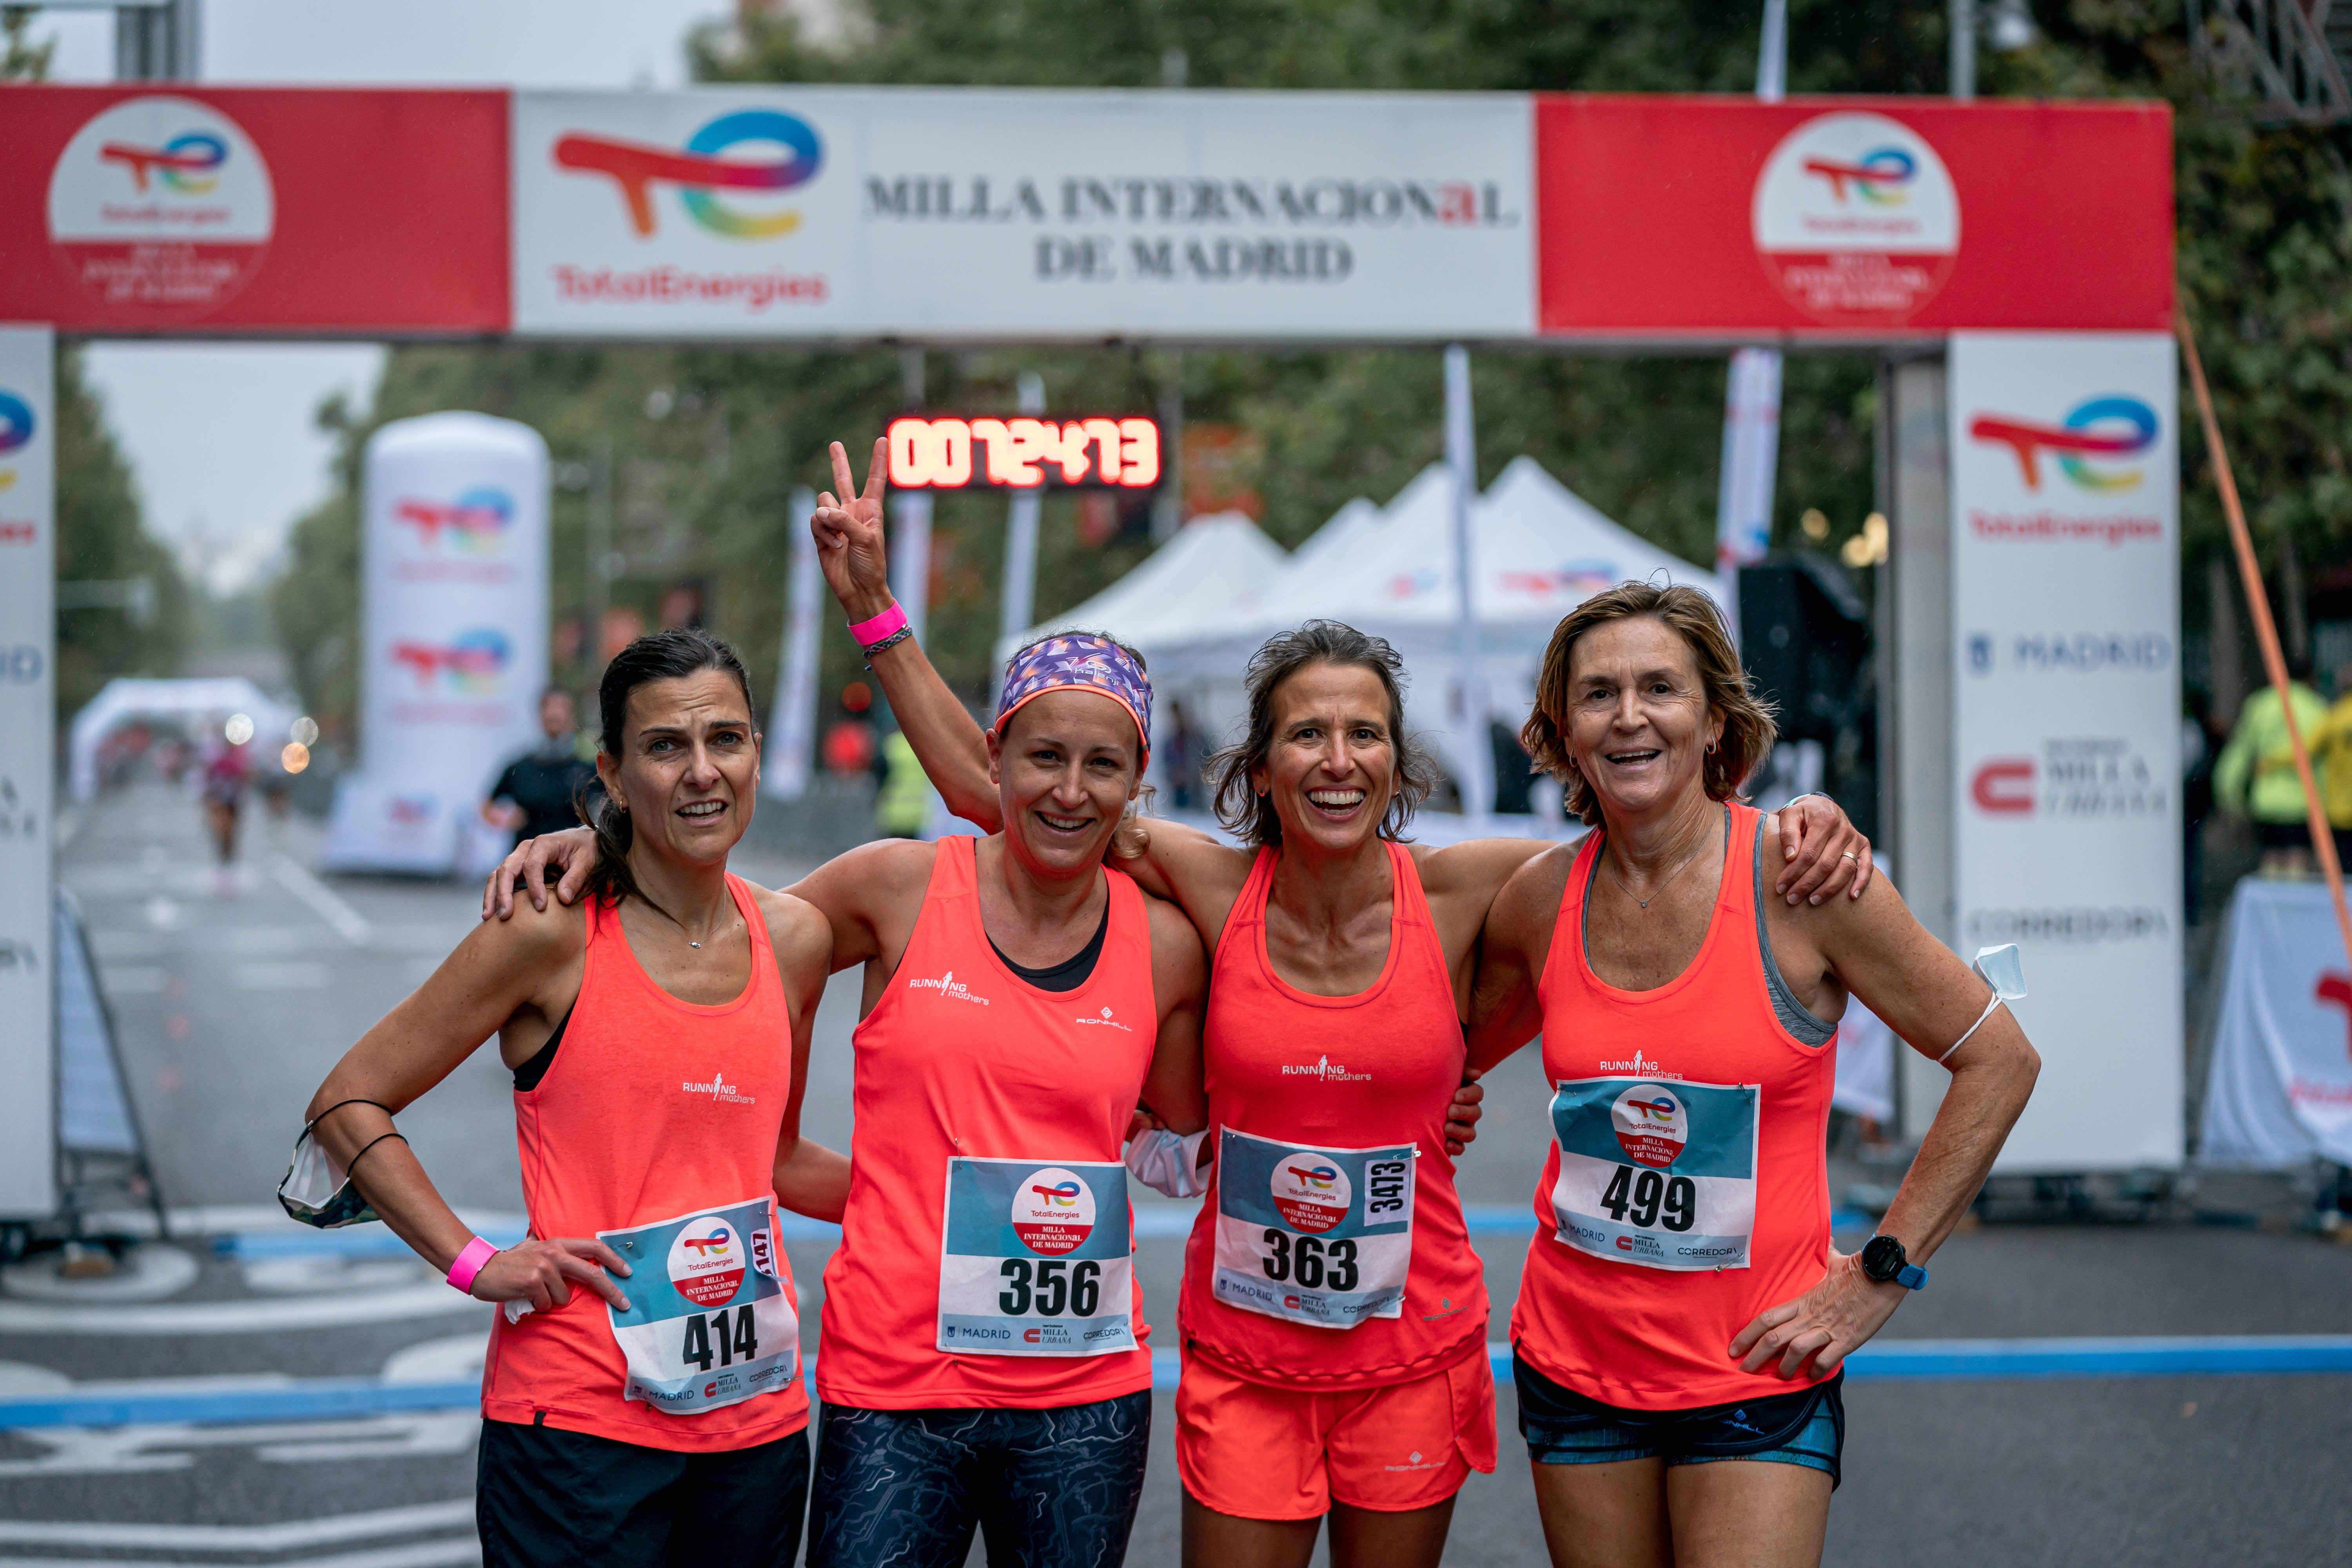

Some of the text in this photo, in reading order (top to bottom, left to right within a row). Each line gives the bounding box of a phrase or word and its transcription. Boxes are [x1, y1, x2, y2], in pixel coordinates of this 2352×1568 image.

[865, 176, 1045, 223] MILLA
[1035, 235, 1355, 284] DE MADRID
[2014, 632, 2172, 672] MADRID
[948, 991, 989, 1005] mothers
[1328, 1072, 1372, 1081] mothers
[1642, 1069, 1683, 1080] mothers
[720, 1093, 755, 1104] mothers
[1629, 1123, 1677, 1134] TotalEnergies
[1642, 1137, 1664, 1146] MILLA
[1646, 1152, 1671, 1163] MADRID
[1370, 1161, 1406, 1214] 3473
[1288, 1188, 1336, 1200] TotalEnergies
[1600, 1164, 1696, 1232] 499
[1299, 1203, 1321, 1213] MILLA
[1031, 1210, 1080, 1219] TotalEnergies
[1300, 1218, 1329, 1229] MADRID
[1570, 1224, 1605, 1242] MADRID
[1634, 1238, 1661, 1249] MILLA
[1634, 1246, 1664, 1257] URBANA
[688, 1258, 733, 1271] TotalEnergies
[1263, 1228, 1359, 1291] 363
[703, 1275, 725, 1285] MILLA
[999, 1258, 1101, 1317] 356
[1233, 1283, 1272, 1301] MADRID
[708, 1289, 733, 1299] MADRID
[1302, 1298, 1327, 1308] MILLA
[683, 1303, 758, 1372] 414
[963, 1328, 1011, 1339] MADRID
[718, 1377, 739, 1387] MILLA
[717, 1383, 742, 1395] URBANA
[649, 1390, 694, 1401] MADRID
